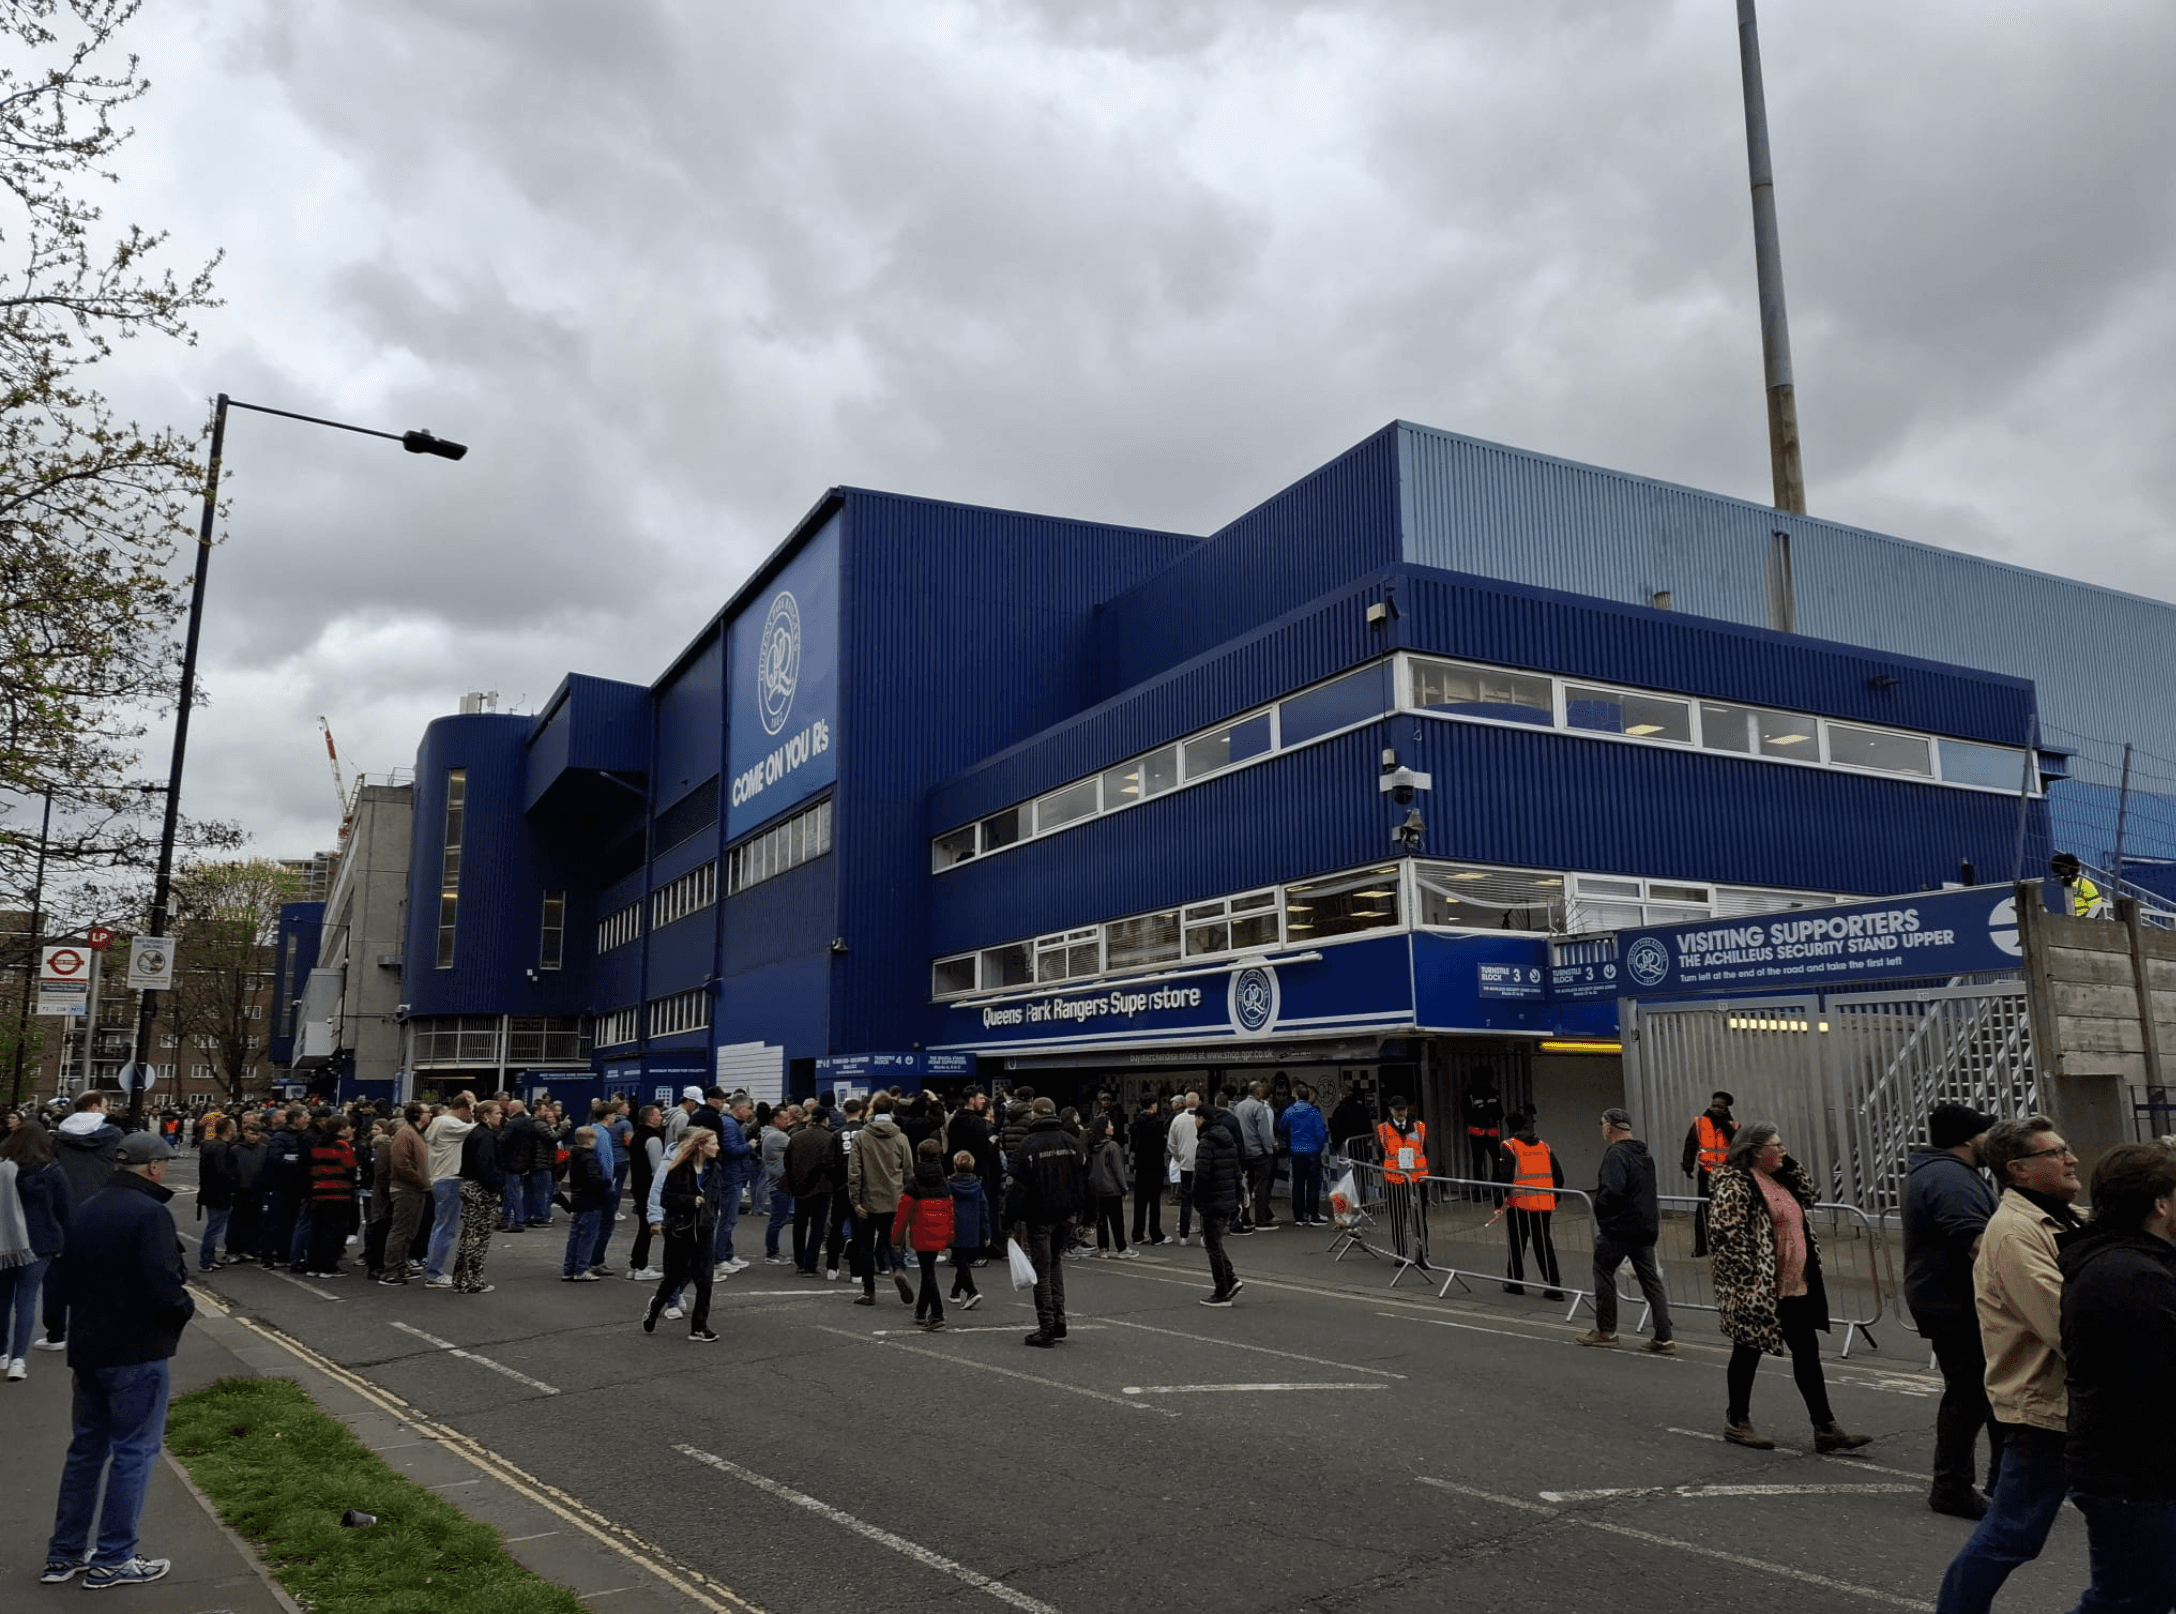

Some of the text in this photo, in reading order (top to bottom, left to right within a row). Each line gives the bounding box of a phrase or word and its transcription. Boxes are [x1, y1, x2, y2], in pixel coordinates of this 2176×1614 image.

[732, 761, 764, 807] COME
[765, 747, 784, 786] ON
[785, 729, 809, 772] YOU
[92, 932, 108, 942] LP
[1676, 908, 1920, 953] VISITING SUPPORTERS
[1678, 929, 1955, 968] THE ACHILLEUS SECURITY STAND UPPER
[1480, 966, 1521, 983] TURNSTILE 3
[1481, 973, 1502, 981] BLOCK
[1585, 966, 1594, 981] 3
[1680, 956, 1902, 983] Turn left at the end of the road and take the first left
[1553, 975, 1574, 984] BLOCK
[983, 1006, 1022, 1030] Queens
[1026, 1000, 1052, 1024] Park
[1053, 996, 1109, 1023] Rangers
[895, 1055, 902, 1065] 4
